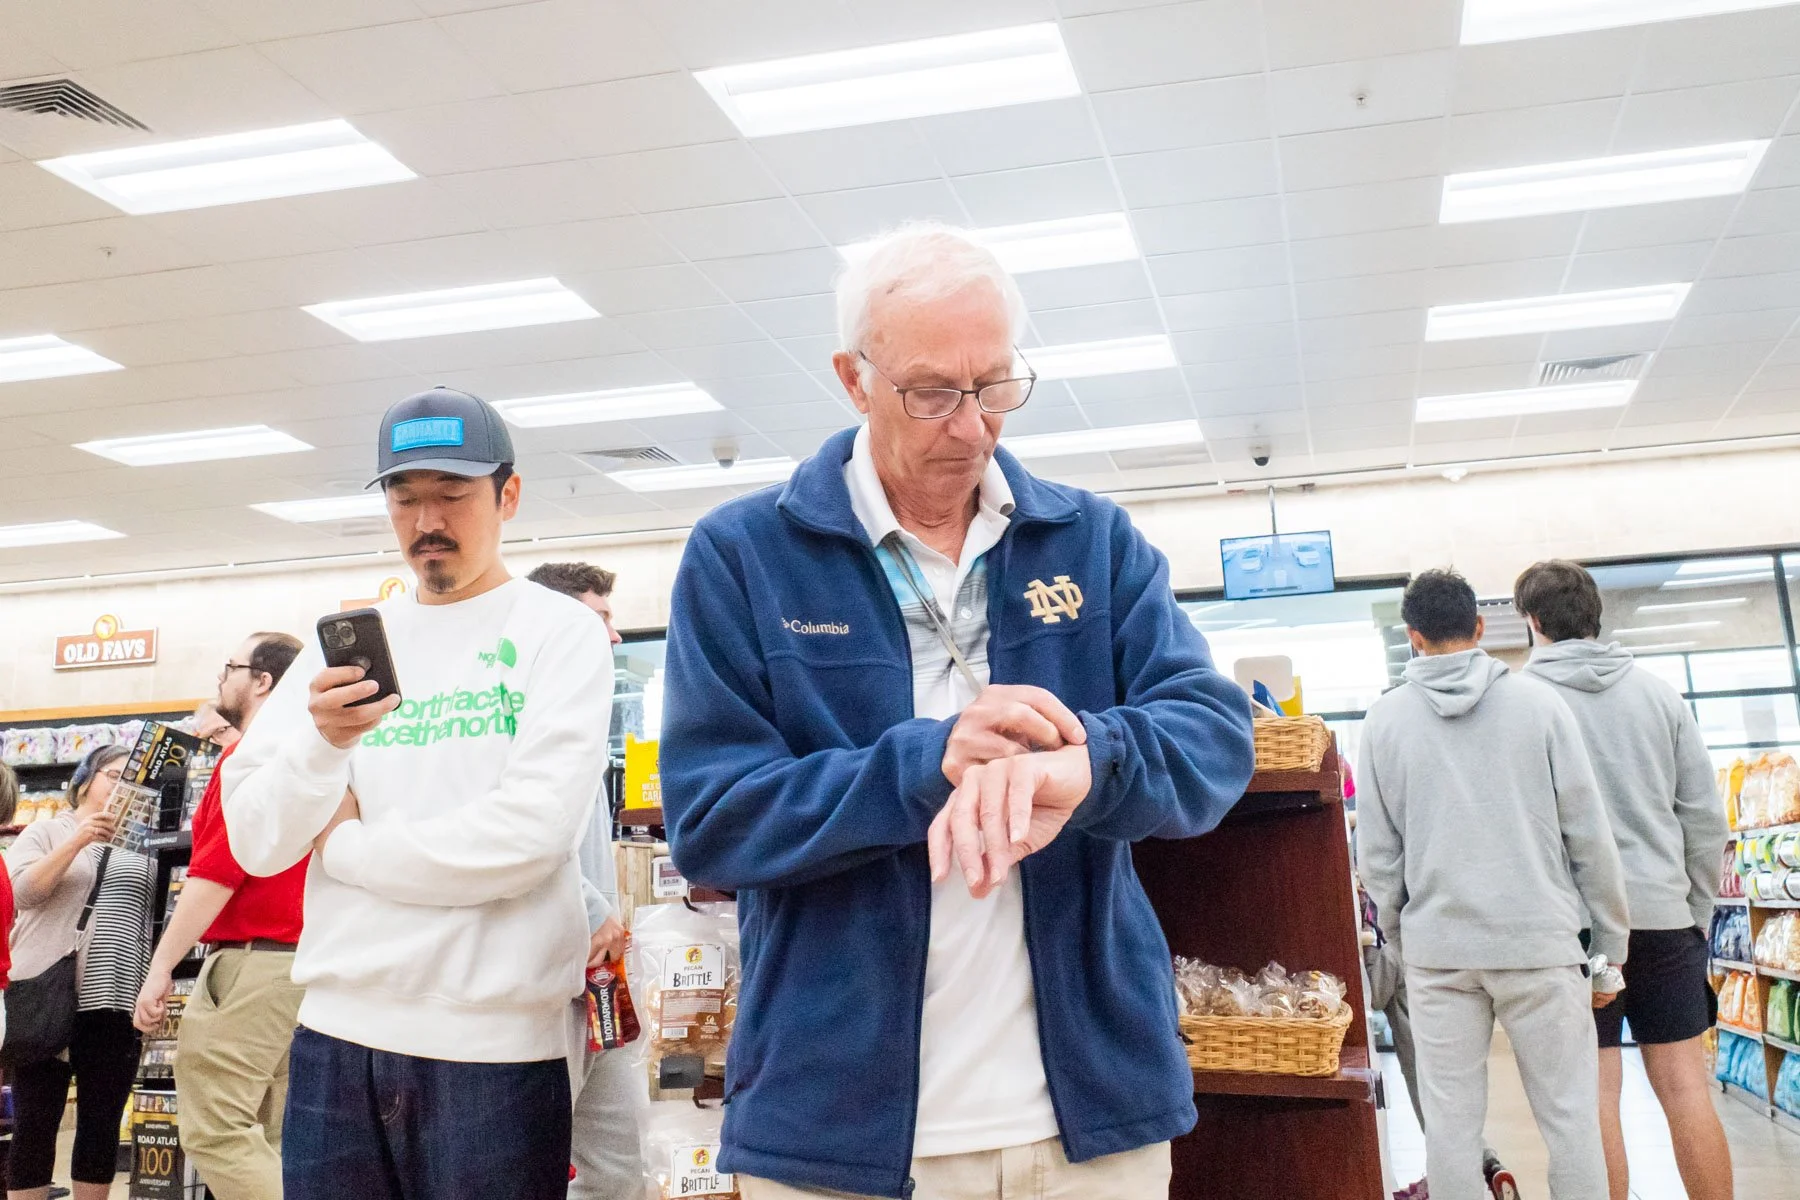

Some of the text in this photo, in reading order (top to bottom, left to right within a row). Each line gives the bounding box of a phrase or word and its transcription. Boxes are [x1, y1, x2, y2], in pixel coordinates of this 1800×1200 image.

[790, 619, 850, 634] Columbia
[63, 639, 146, 663] OLD FAVS
[149, 759, 164, 780] ROAD
[159, 736, 173, 759] ATLAS
[673, 971, 713, 988] BRITTLE
[600, 987, 614, 1041] BODYARMOR
[137, 1135, 178, 1146] ROAD ATLAS
[139, 1147, 172, 1176] 100
[681, 1173, 720, 1194] BRITTLE
